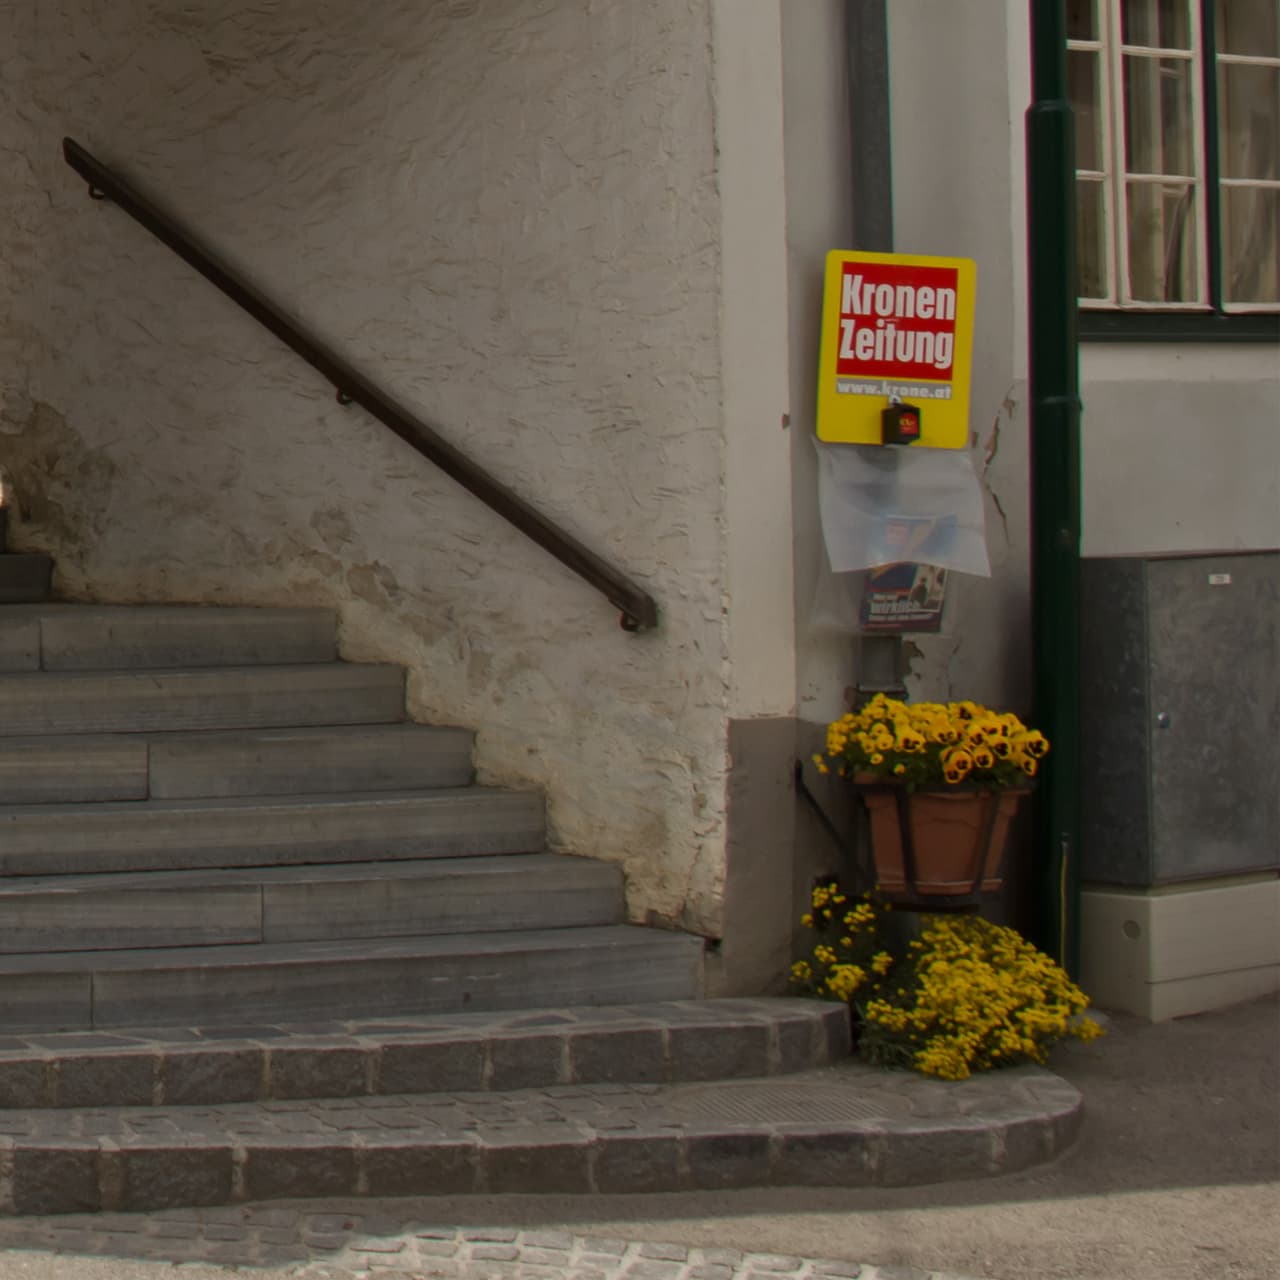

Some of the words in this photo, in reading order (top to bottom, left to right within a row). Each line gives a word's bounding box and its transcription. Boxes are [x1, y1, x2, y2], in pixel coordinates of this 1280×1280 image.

[841, 273, 956, 320] Kronen
[839, 318, 955, 370] Zeitung
[837, 380, 952, 400] www.krone.at
